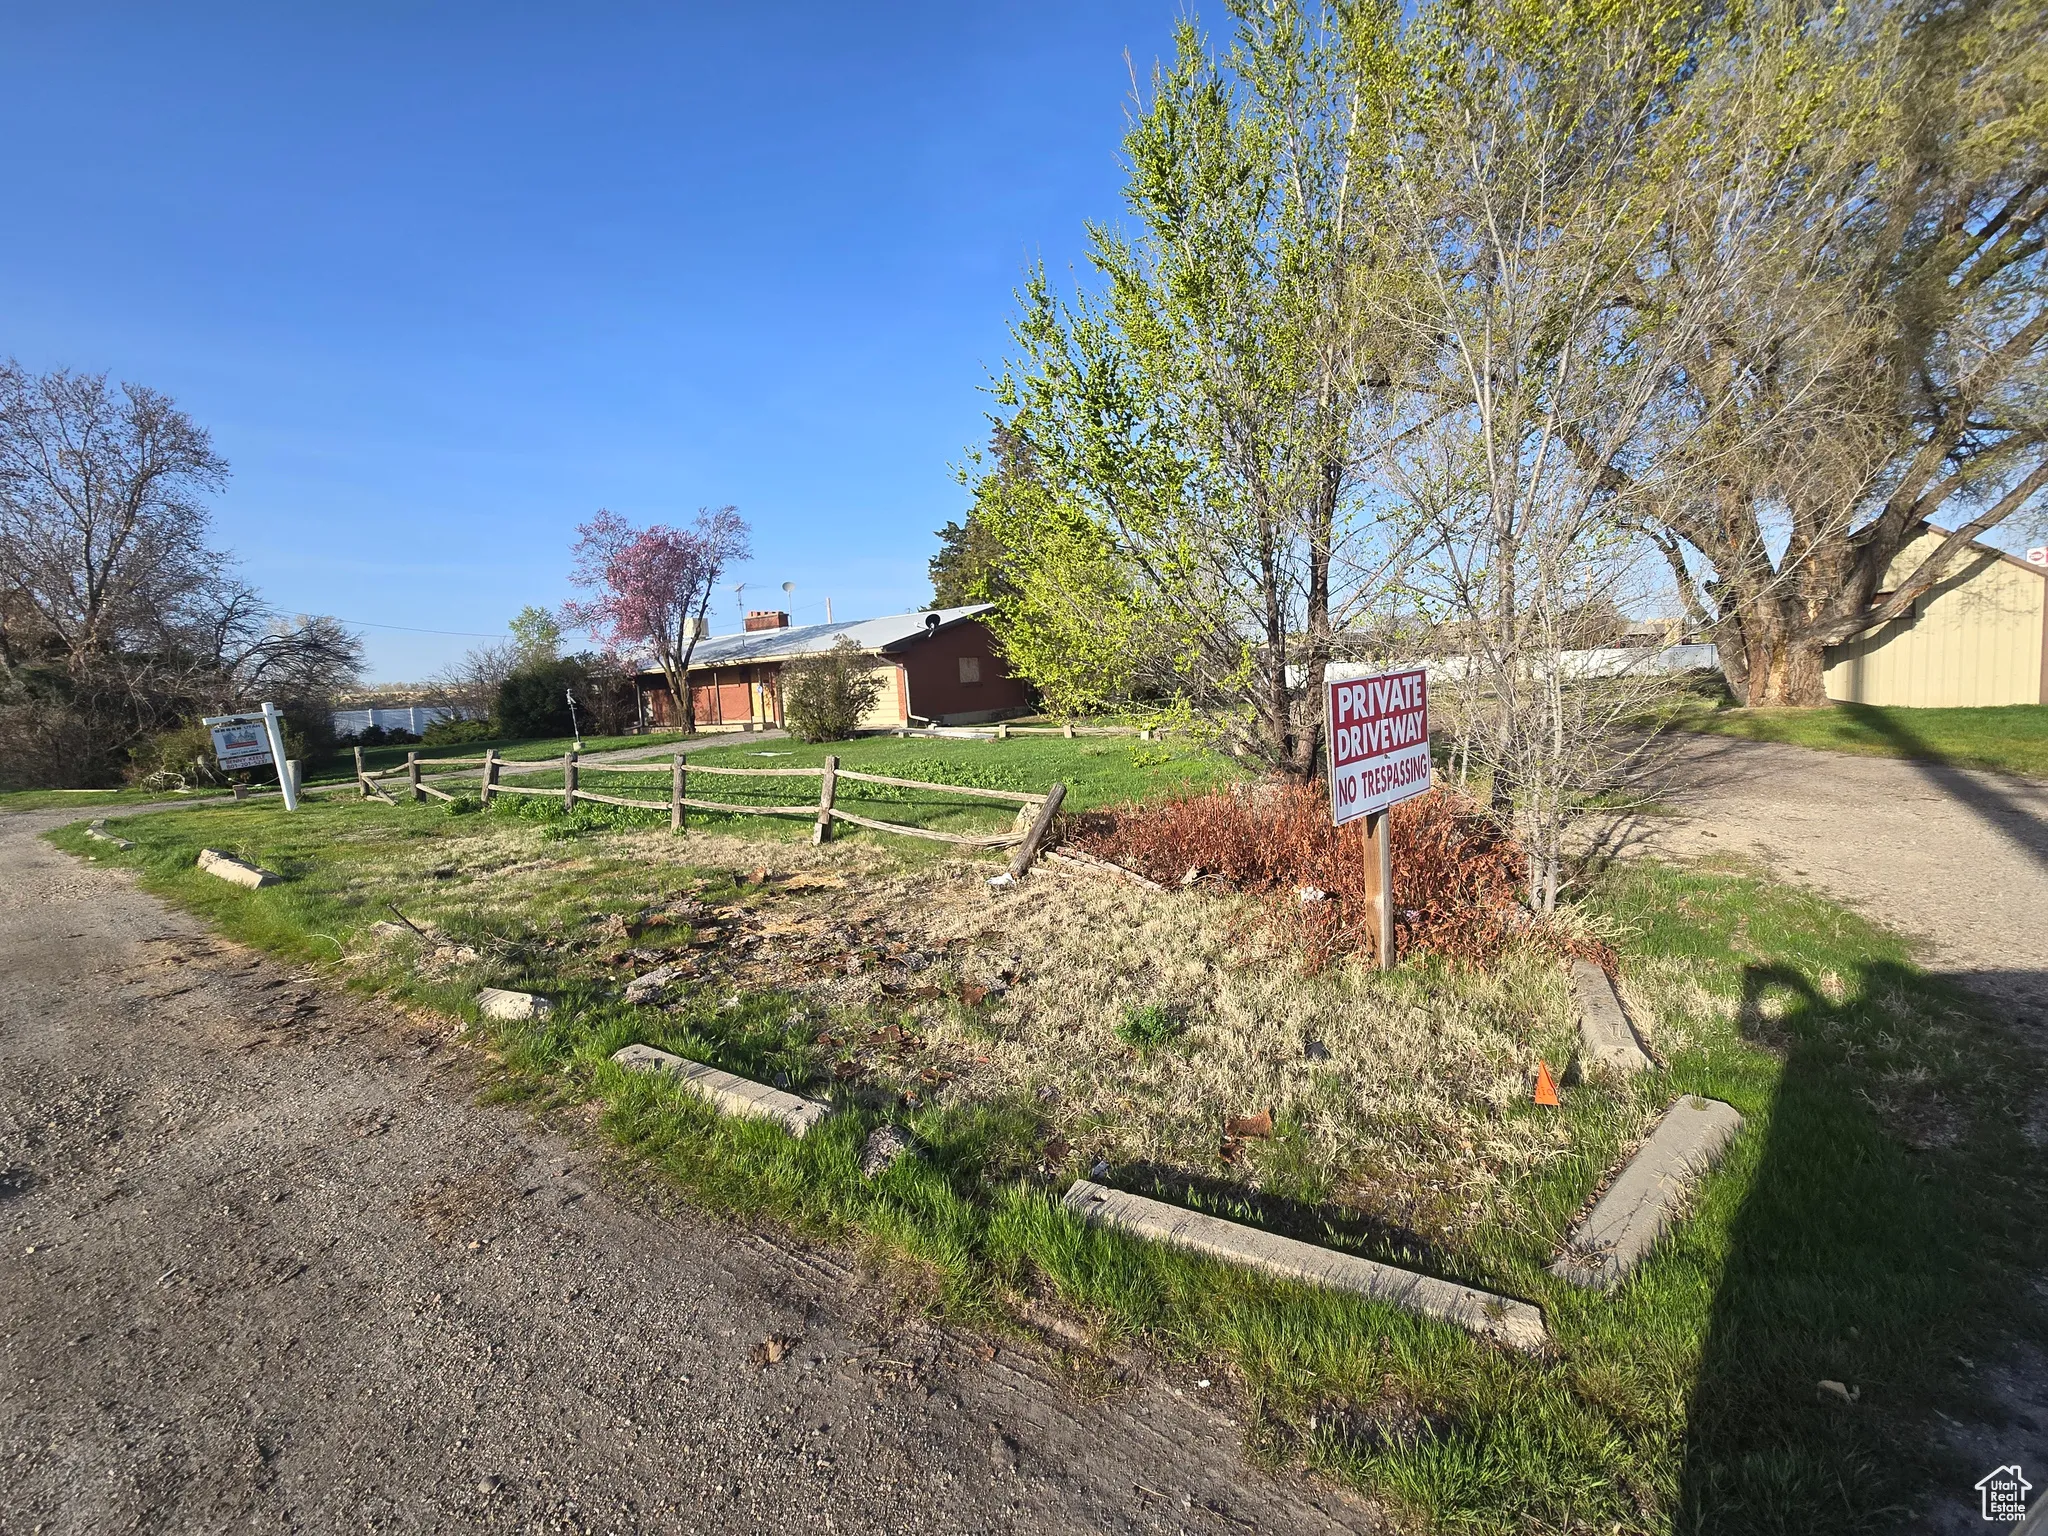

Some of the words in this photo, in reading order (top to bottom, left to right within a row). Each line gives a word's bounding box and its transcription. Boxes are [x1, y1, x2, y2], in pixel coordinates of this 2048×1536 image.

[1337, 674, 1422, 724] PRIVATE
[1337, 710, 1425, 762] DRIVEWAY
[1338, 775, 1357, 808] NO
[1361, 753, 1427, 799] TRESPASSING
